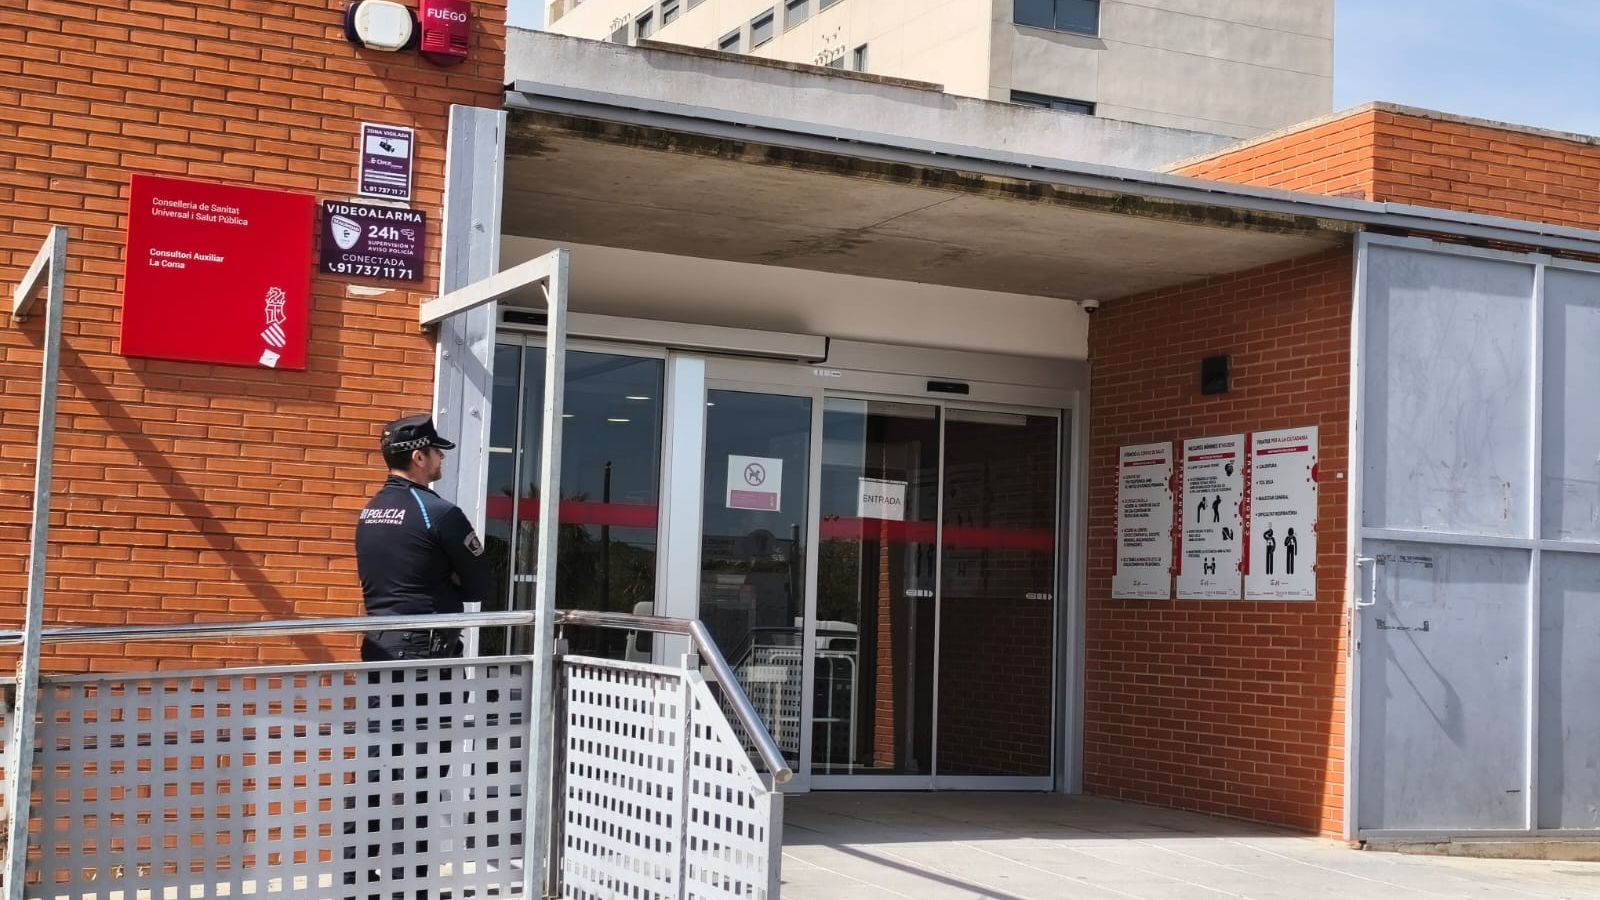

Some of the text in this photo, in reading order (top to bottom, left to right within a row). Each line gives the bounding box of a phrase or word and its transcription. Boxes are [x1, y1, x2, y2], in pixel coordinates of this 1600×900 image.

[427, 8, 467, 22] FUEGO
[152, 197, 240, 215] Conselleria de Sanitat
[326, 204, 422, 223] VIDEOALARMA
[151, 207, 249, 226] Universal i Salut Pública
[368, 225, 399, 240] 24h
[368, 240, 409, 249] SUPERVISIÓN
[149, 248, 224, 263] Consultori Auxiliar
[342, 253, 405, 267] CONECTADA
[149, 258, 185, 269] La Coma
[337, 263, 413, 280] 91 737 11 71
[863, 494, 901, 505] ENTRADA
